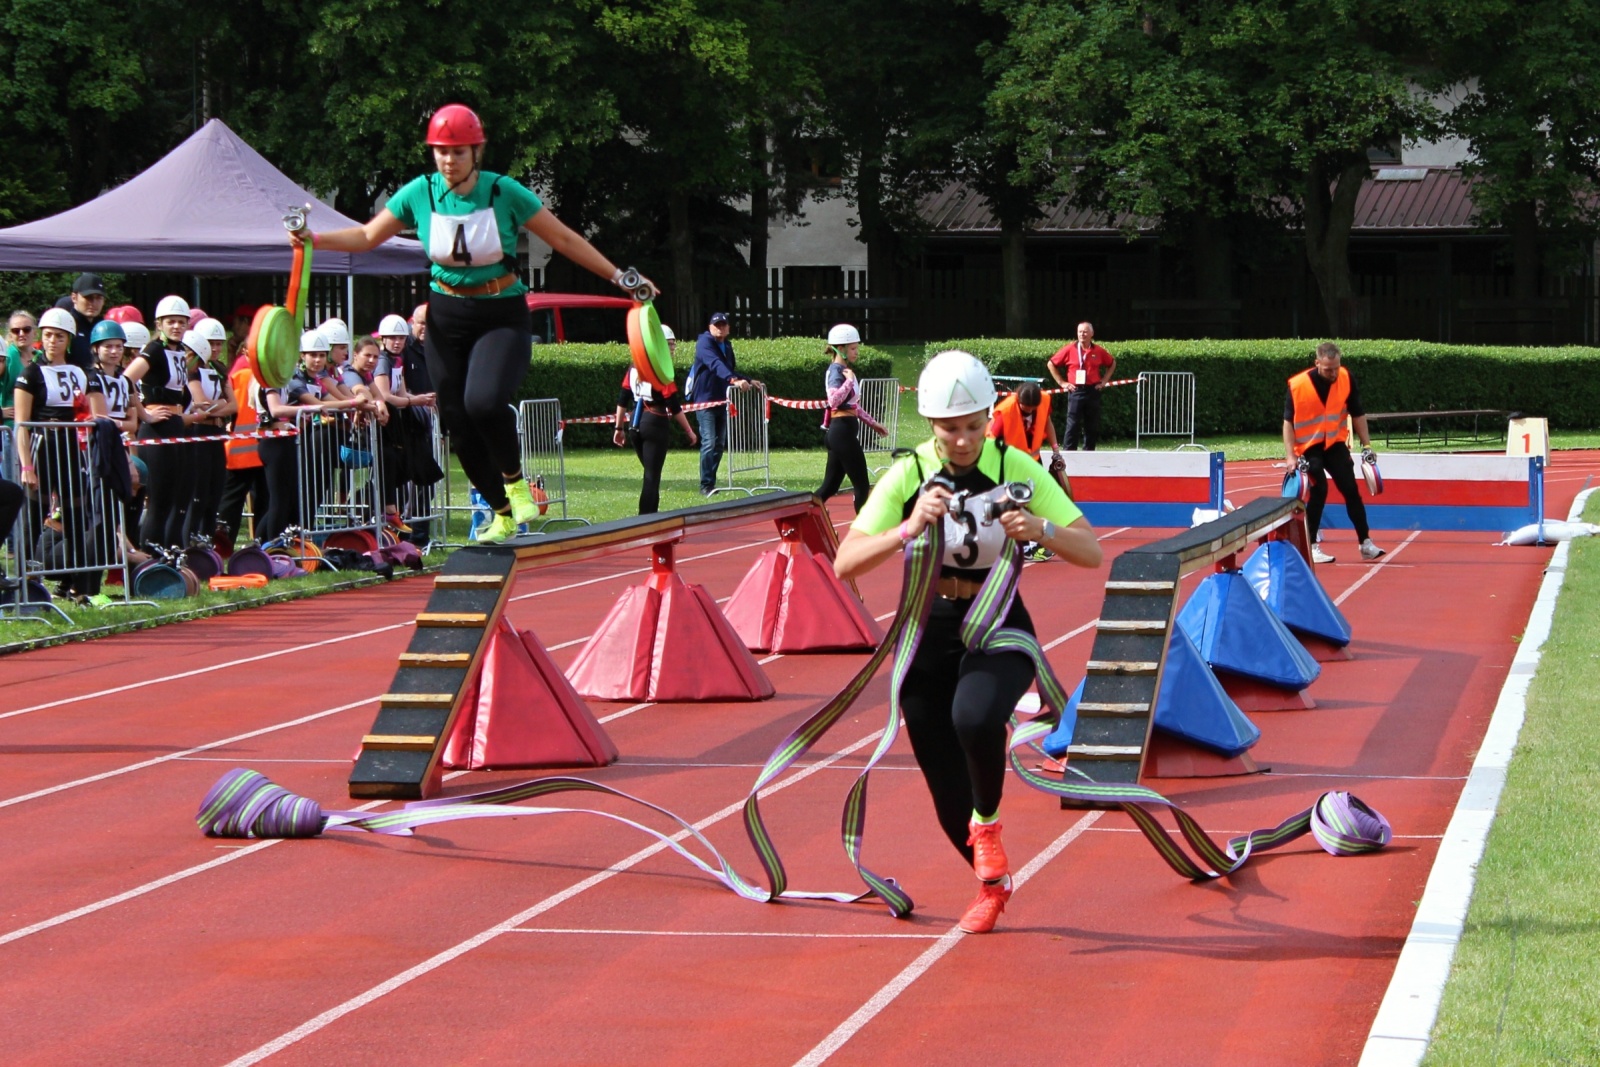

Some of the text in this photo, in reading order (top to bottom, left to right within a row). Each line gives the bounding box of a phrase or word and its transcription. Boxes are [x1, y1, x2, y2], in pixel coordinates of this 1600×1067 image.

[451, 223, 473, 266] 4
[1521, 433, 1531, 454] 1
[952, 510, 979, 568] 3
